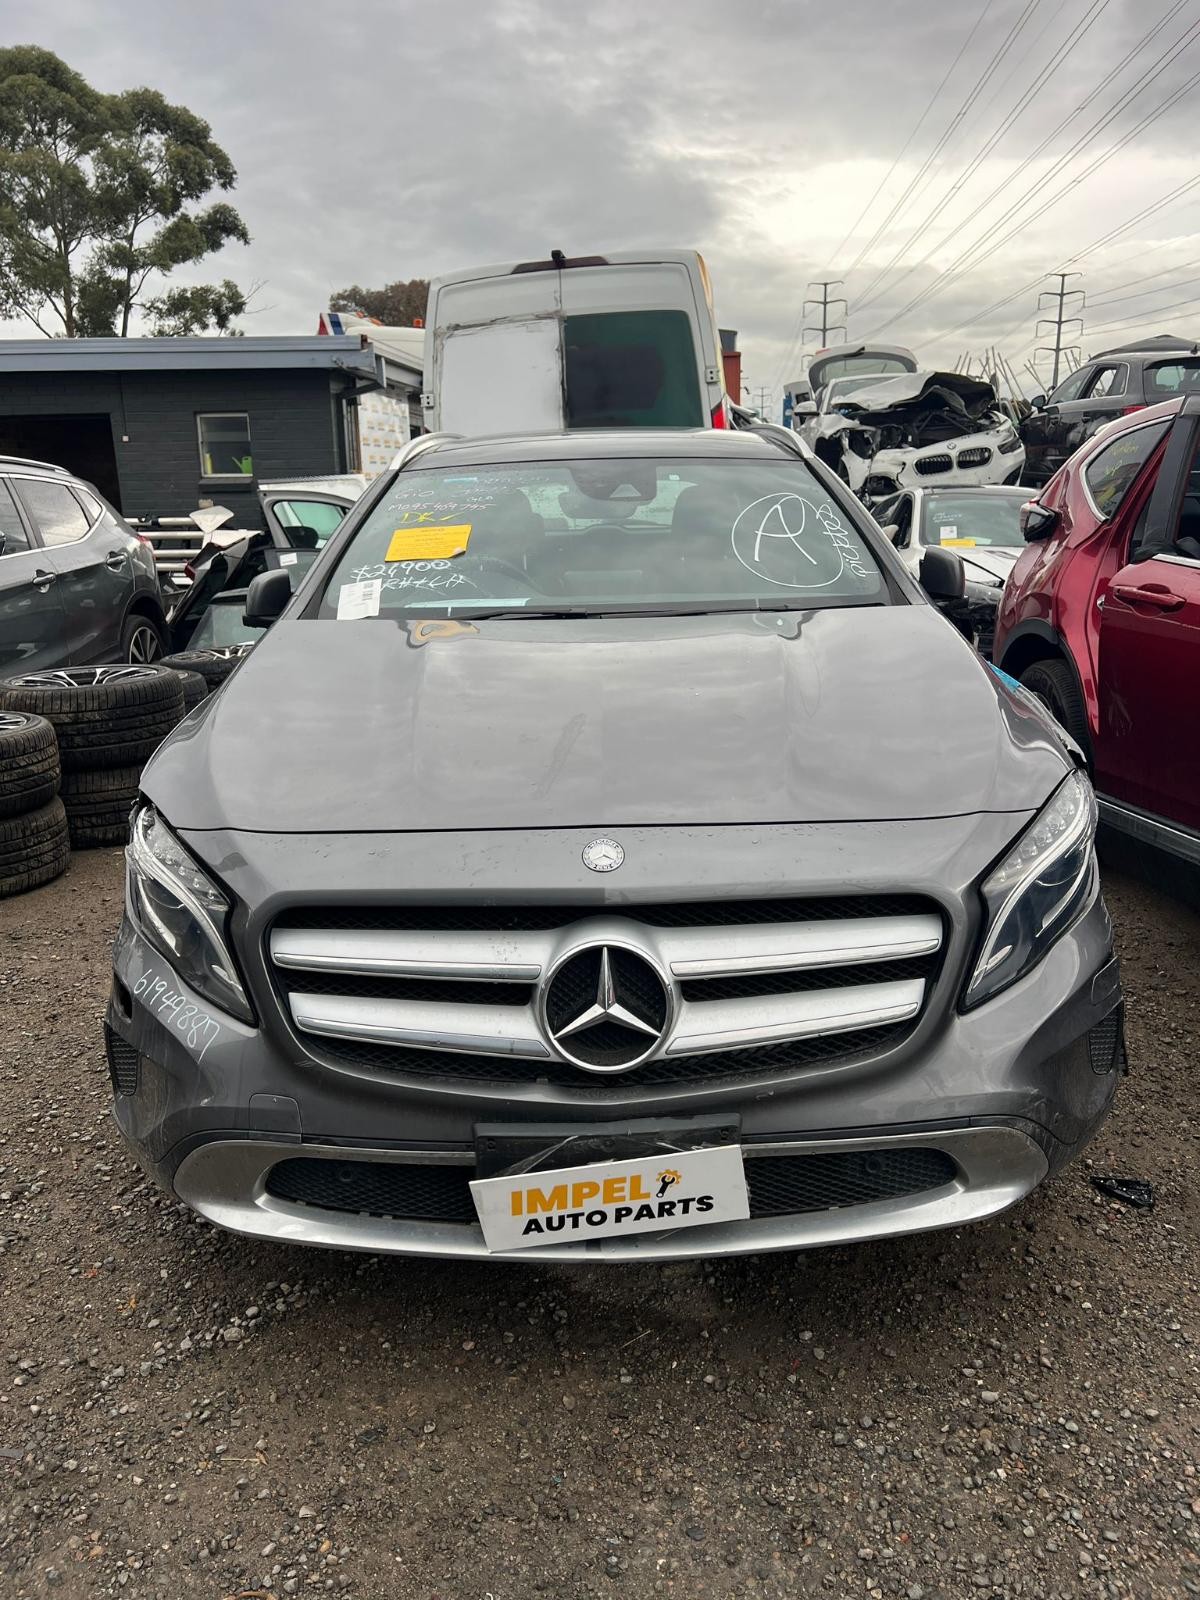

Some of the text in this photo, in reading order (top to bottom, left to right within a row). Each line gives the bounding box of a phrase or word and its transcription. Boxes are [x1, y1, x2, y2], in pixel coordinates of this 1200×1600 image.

[133, 968, 220, 1063] 61949887
[511, 1174, 651, 1217] IMPEL
[522, 1195, 714, 1236] AUTO PARTS
